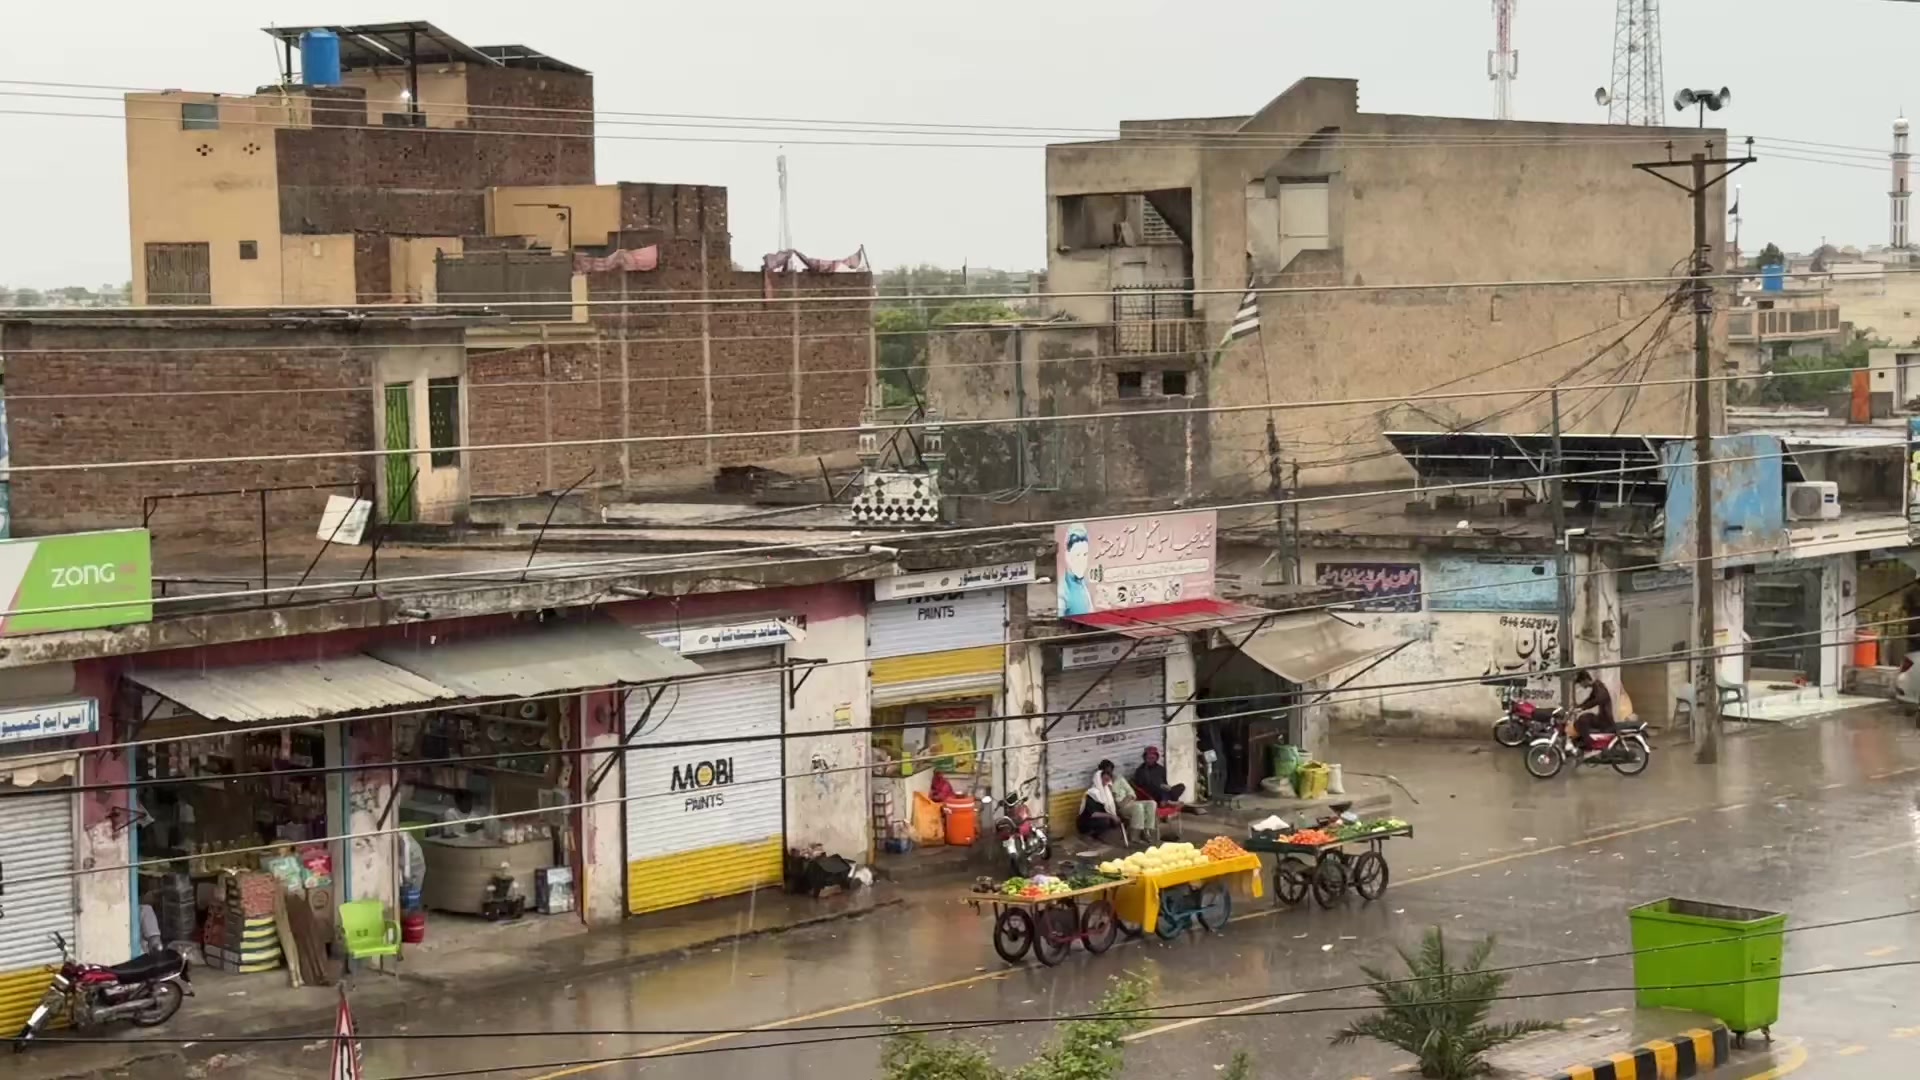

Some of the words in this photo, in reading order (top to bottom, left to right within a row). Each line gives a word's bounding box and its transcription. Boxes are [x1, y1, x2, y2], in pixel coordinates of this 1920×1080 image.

[917, 606, 955, 620] PAINTS
[671, 757, 734, 791] MOBI
[684, 792, 725, 812] PAINTS
